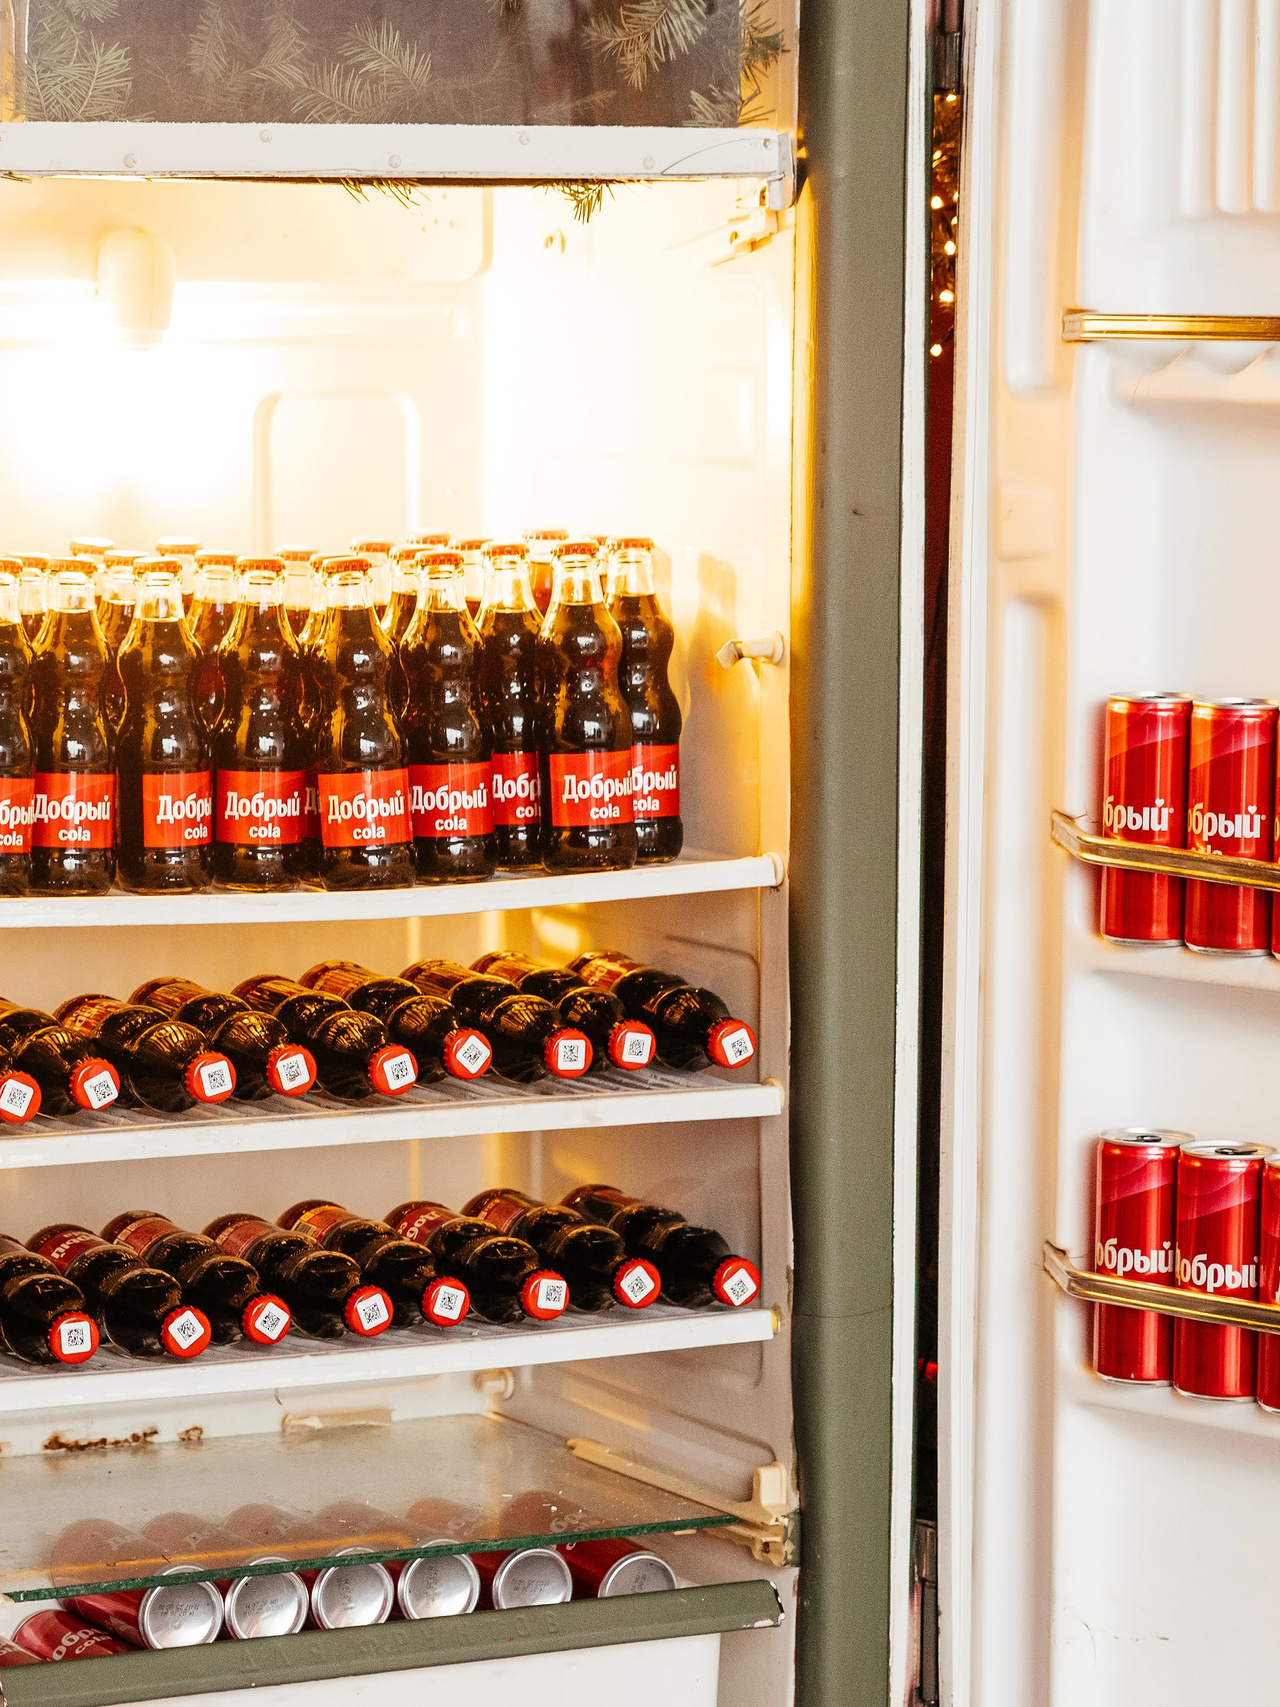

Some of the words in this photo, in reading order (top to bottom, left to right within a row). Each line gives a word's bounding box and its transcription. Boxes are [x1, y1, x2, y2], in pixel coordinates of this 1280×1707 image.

[562, 770, 632, 803] Добрый
[632, 764, 677, 795] брый
[34, 794, 111, 825] Добрый
[156, 793, 212, 824] Добры
[225, 791, 301, 822] Добрый
[327, 790, 405, 824] Добрый
[411, 782, 488, 814] Добрый
[515, 802, 542, 818] col
[590, 803, 620, 819] cola
[435, 815, 467, 831] cola
[1103, 795, 1170, 834] брый
[58, 826, 91, 841] cola
[184, 823, 208, 839] cola
[249, 823, 281, 838] cola
[352, 823, 385, 840] cola
[1095, 1237, 1174, 1277] обрый
